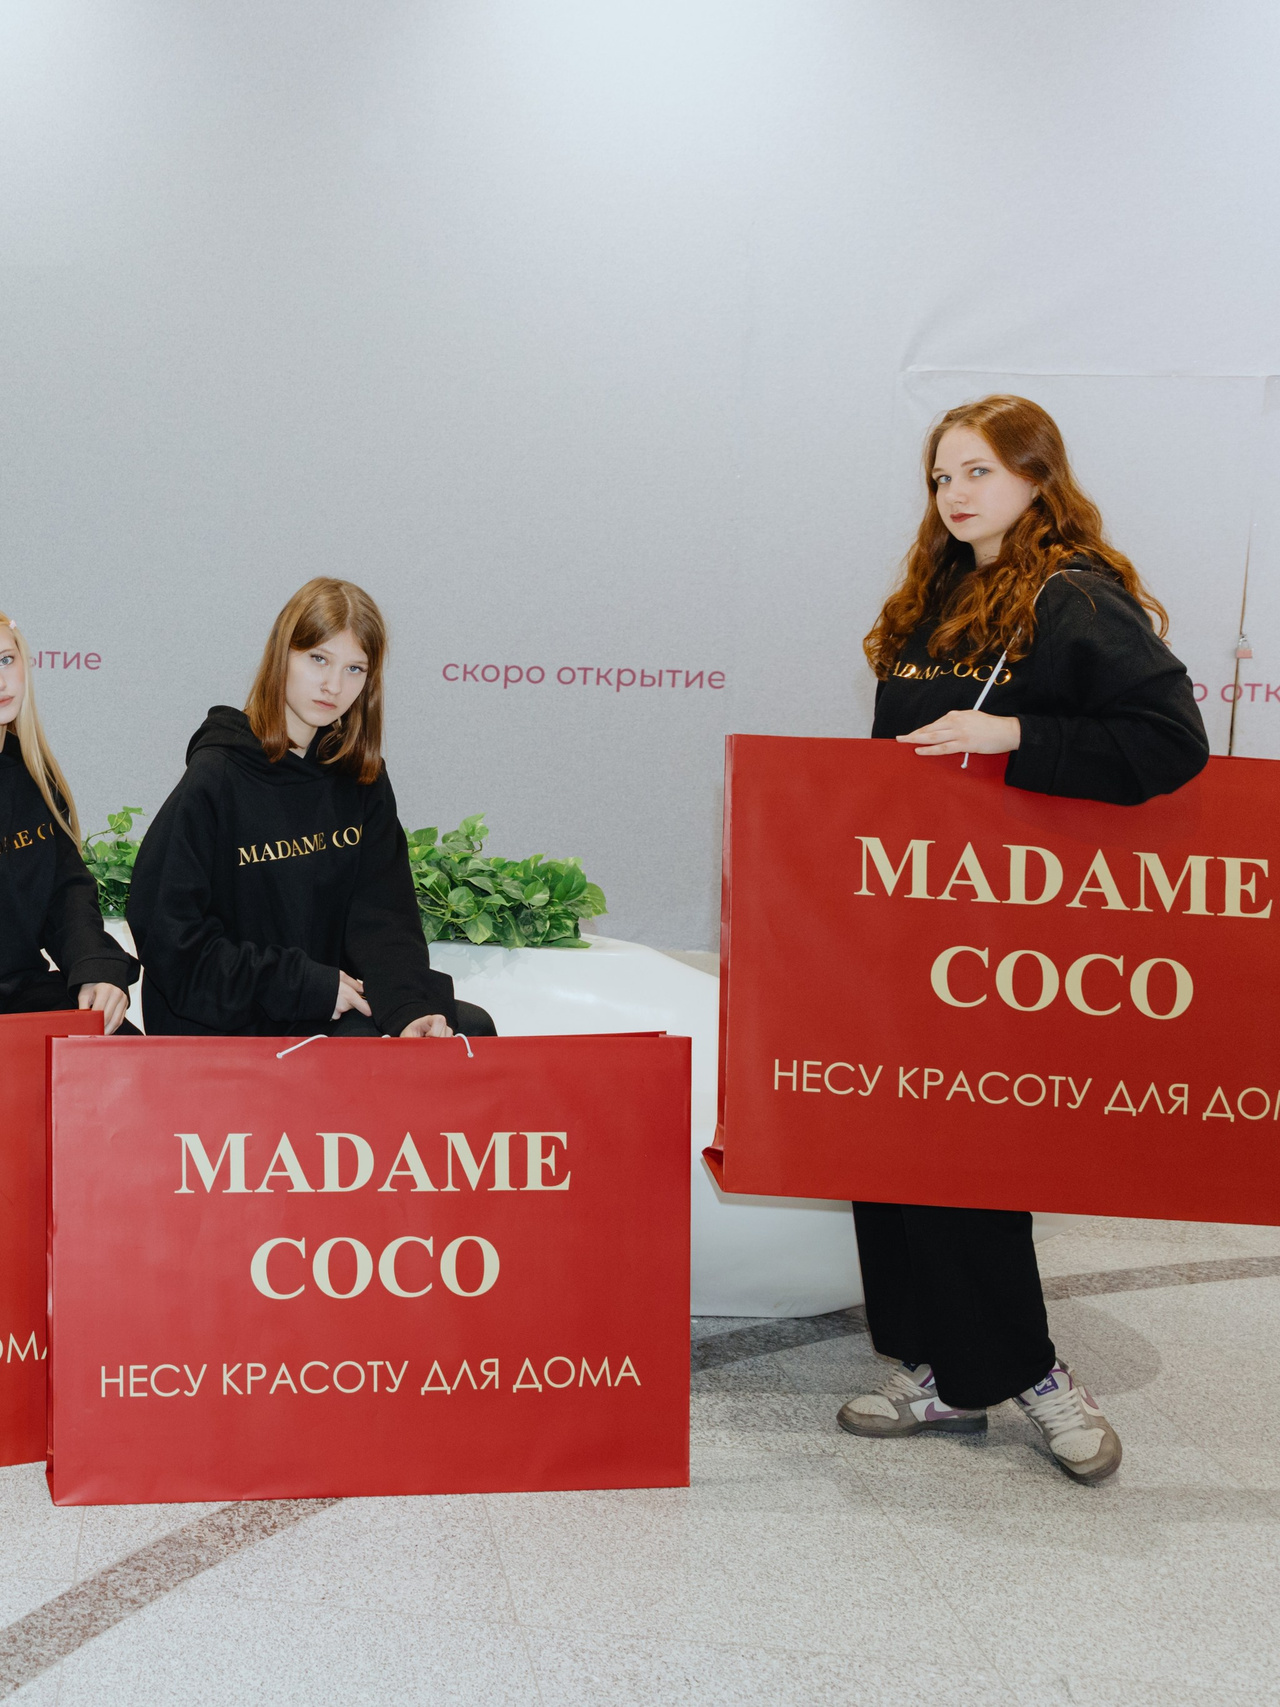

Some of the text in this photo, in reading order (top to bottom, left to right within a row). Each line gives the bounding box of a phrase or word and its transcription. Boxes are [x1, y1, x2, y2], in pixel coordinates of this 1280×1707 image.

[442, 663, 726, 693] скоро открытие
[237, 823, 363, 866] MADAME CO
[853, 835, 1274, 920] MADAME
[930, 945, 1195, 1020] COCO
[773, 1058, 1280, 1123] НЕСУ КРАСОТУ ДЛЯ ДО
[173, 1131, 572, 1194] MADAME
[250, 1235, 500, 1300] COCO
[100, 1354, 641, 1398] НЕСУ КРАСОТУ ДЛЯ ДОМА
